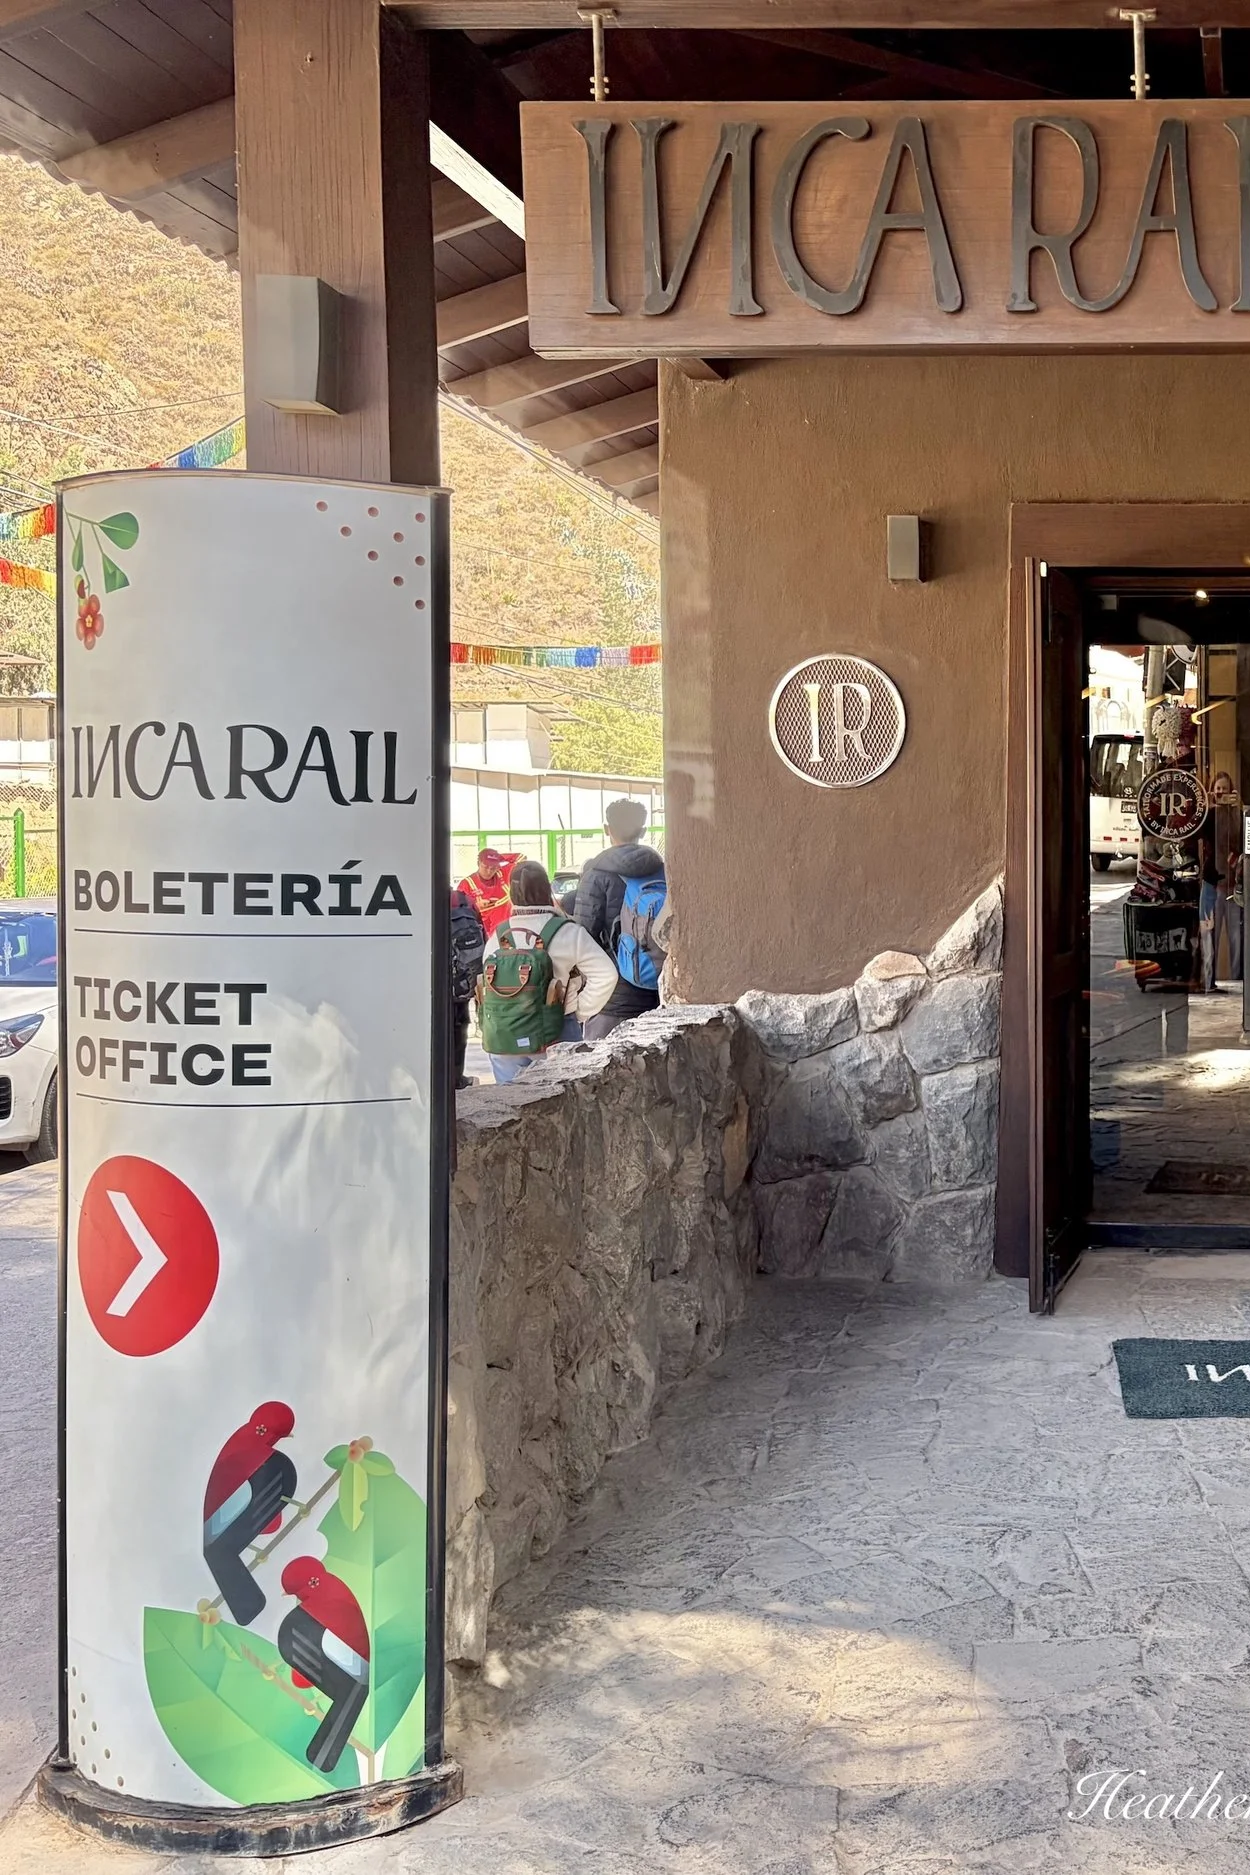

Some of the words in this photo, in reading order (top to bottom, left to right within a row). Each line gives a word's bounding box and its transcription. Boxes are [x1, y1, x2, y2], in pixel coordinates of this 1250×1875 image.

[573, 115, 963, 316] INCA
[803, 682, 873, 763] IR
[71, 720, 216, 801] INCA
[223, 723, 418, 806] RAIL
[1143, 774, 1172, 818] TAILORMADE
[1173, 773, 1204, 817] EXPERIENCES
[1160, 792, 1186, 817] IR
[1150, 820, 1161, 830] BY
[1179, 821, 1196, 835] RAIL
[74, 859, 413, 917] BOLETERÍA
[73, 975, 268, 1026] TICKET
[75, 1035, 272, 1087] OFFICE
